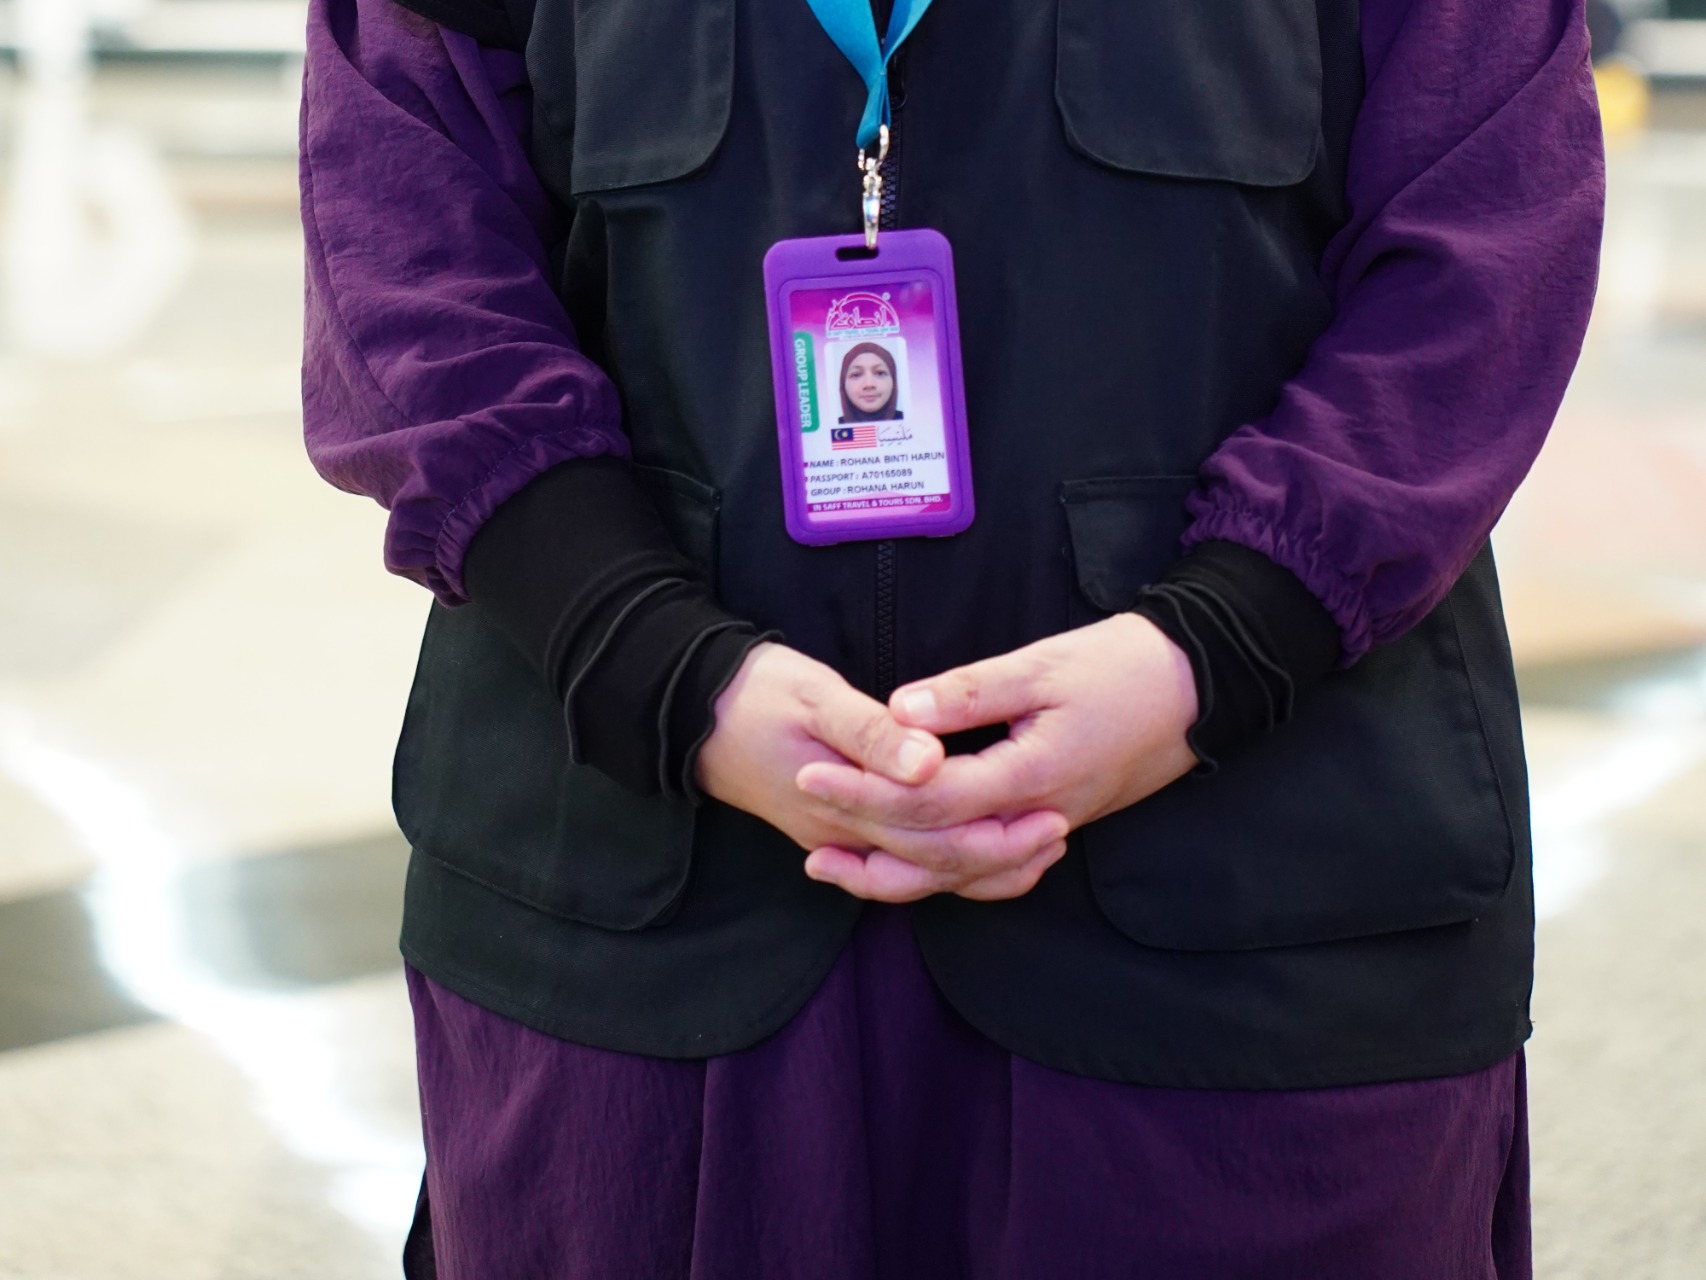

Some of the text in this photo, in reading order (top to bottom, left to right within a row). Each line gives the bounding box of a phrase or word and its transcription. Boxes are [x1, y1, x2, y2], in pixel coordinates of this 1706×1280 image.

[794, 338, 813, 428] GROUP LEADER
[840, 456, 881, 466] ROHANA
[884, 454, 909, 463] BINTI
[911, 452, 945, 461] HARUN
[847, 484, 888, 494] ROHANA
[890, 481, 924, 491] HARUN
[813, 504, 822, 512] IN
[823, 503, 841, 511] SAFF
[842, 501, 870, 510] TRAVEL
[879, 498, 904, 507] TOURS
